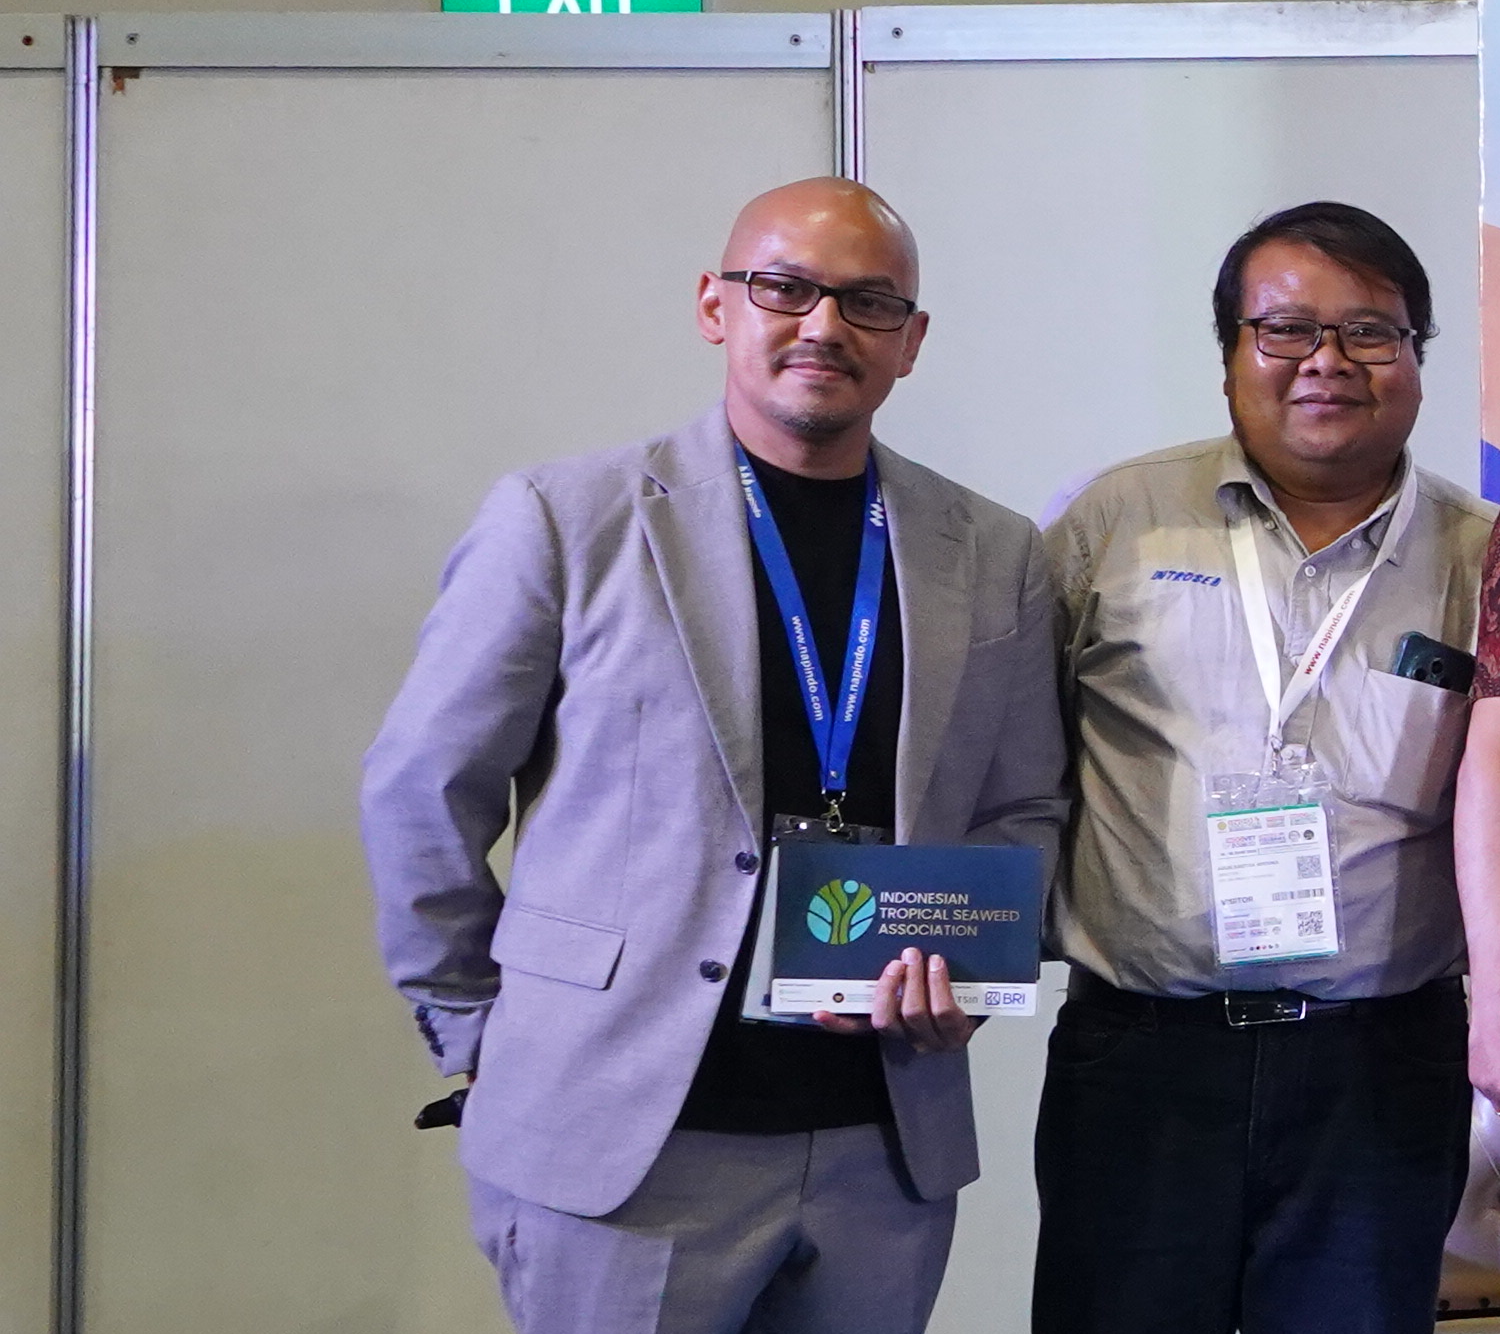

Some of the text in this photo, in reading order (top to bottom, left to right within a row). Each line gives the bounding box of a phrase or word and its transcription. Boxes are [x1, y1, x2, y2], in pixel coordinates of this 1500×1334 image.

[1304, 589, 1356, 676] www.napindo.com
[792, 615, 823, 721] www.napindo.com
[843, 618, 871, 722] www.napindo.com
[880, 891, 969, 906] INDONESIAN
[880, 907, 1020, 923] TROPICAL SEAWEED
[878, 923, 978, 938] ASSOCIATION
[1003, 993, 1025, 1005] BRI
